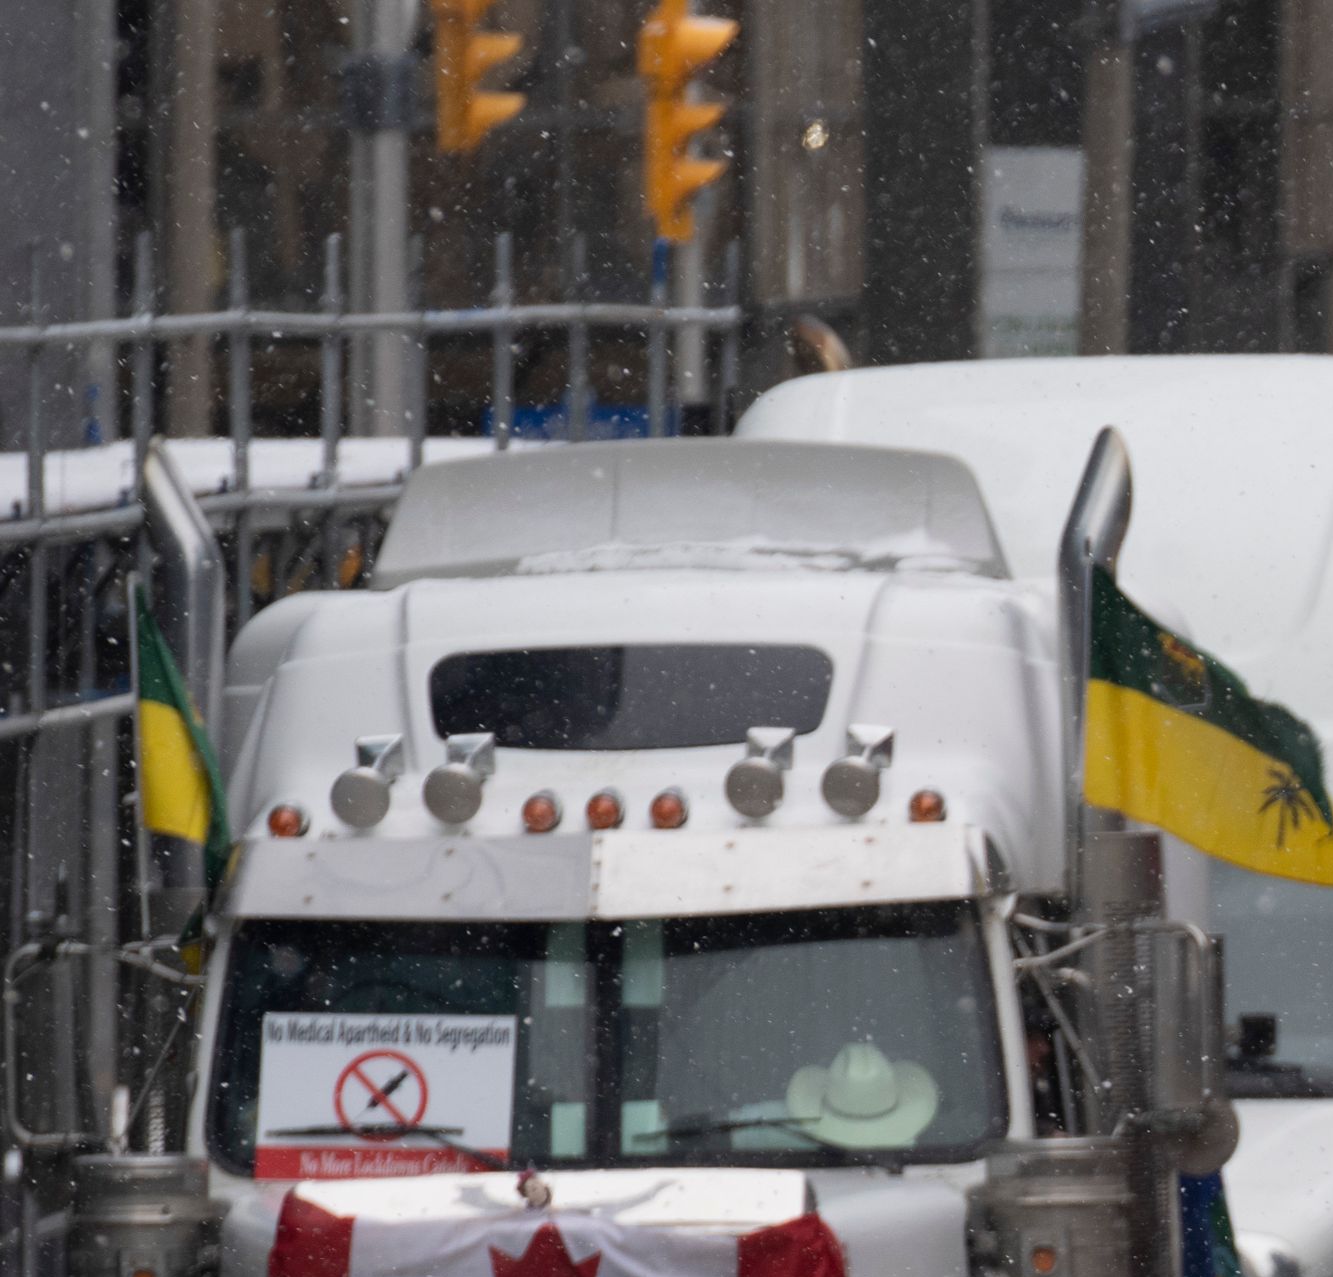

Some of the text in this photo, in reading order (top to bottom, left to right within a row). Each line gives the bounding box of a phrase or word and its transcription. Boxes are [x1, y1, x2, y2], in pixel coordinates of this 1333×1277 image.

[268, 1018, 510, 1052] No Medical Apartheid & No Segregation
[300, 1151, 320, 1176] No
[321, 1151, 350, 1175] More
